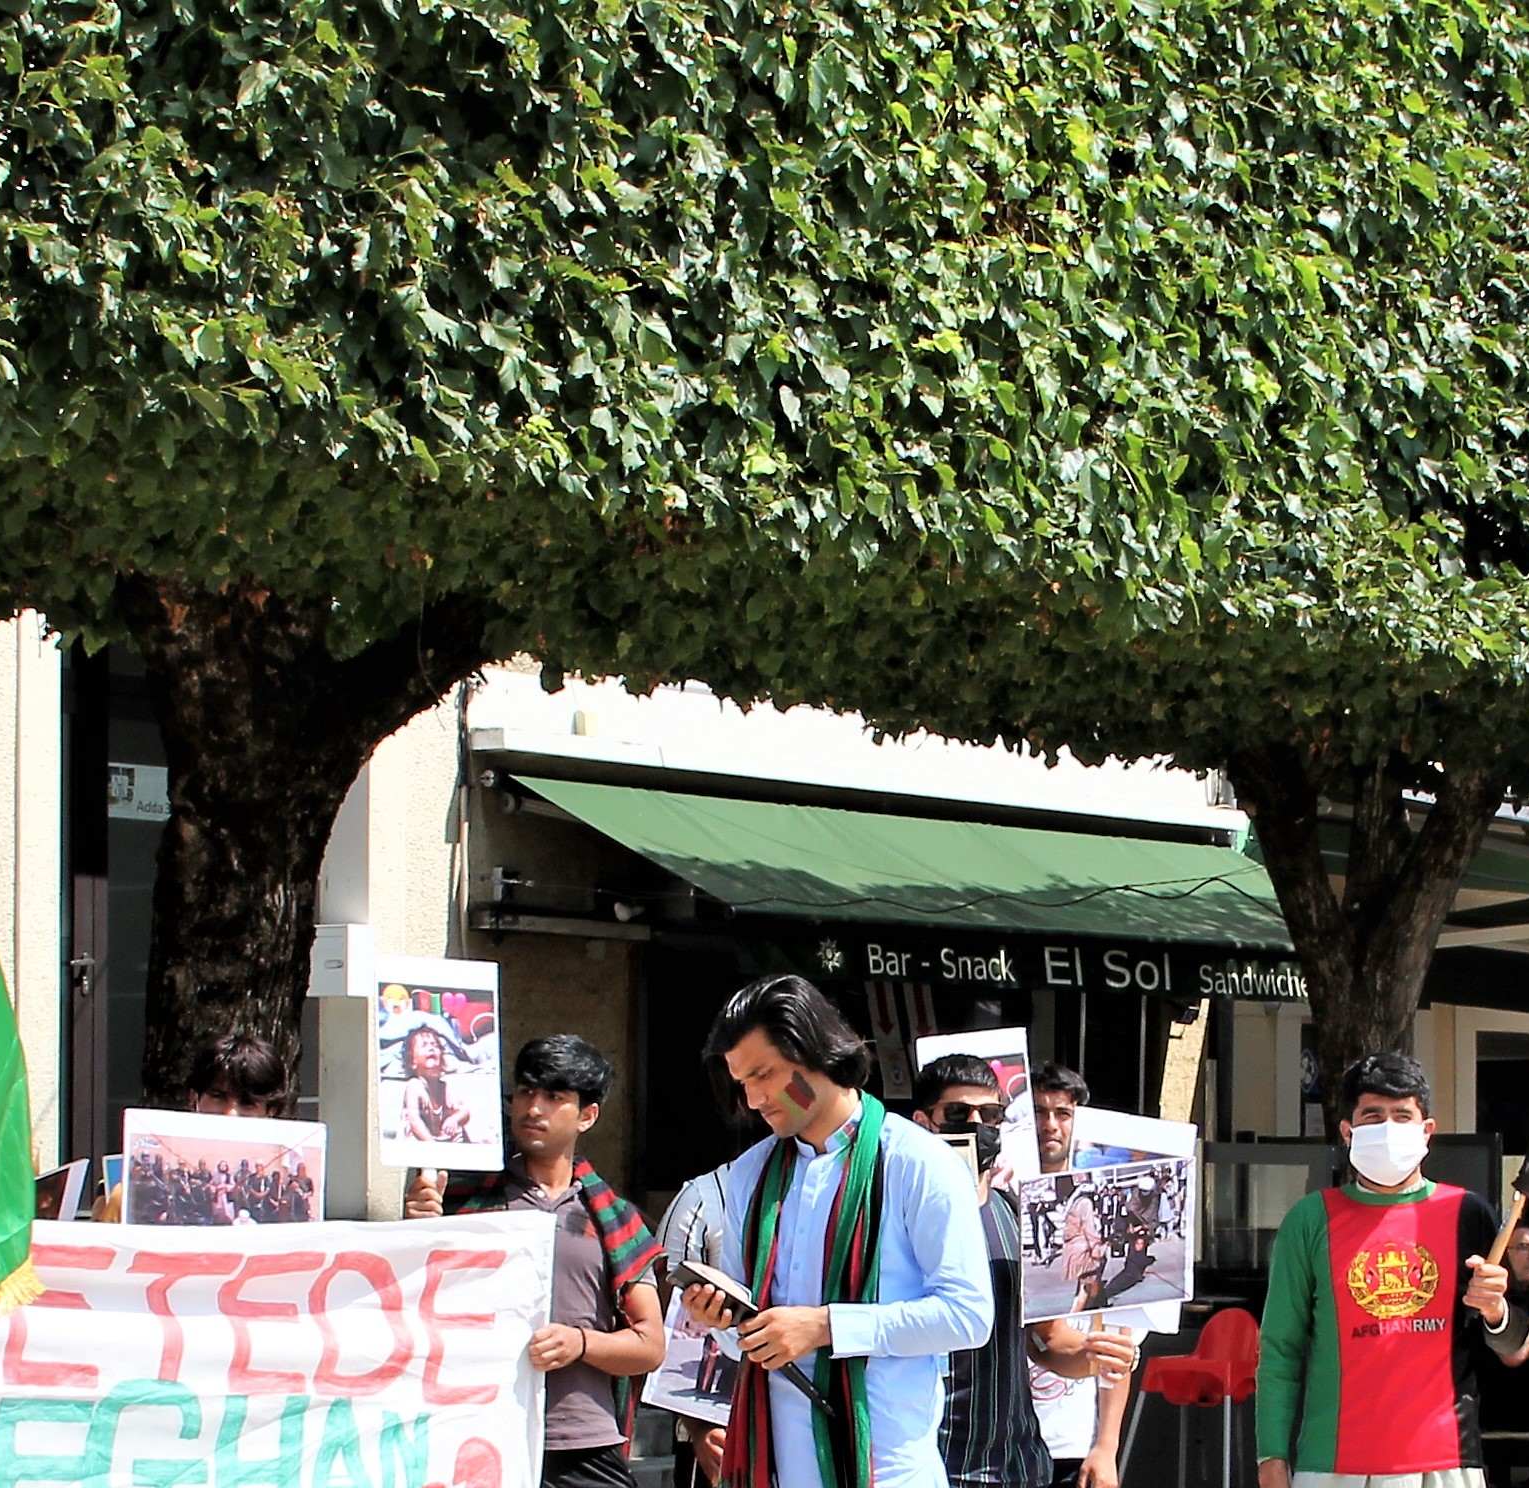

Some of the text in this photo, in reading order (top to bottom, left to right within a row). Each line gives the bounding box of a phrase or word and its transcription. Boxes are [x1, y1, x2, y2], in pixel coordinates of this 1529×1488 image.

[867, 943, 911, 976] Bar
[940, 946, 1016, 982] Snack
[1043, 946, 1083, 986] El
[1102, 949, 1171, 991] Sol
